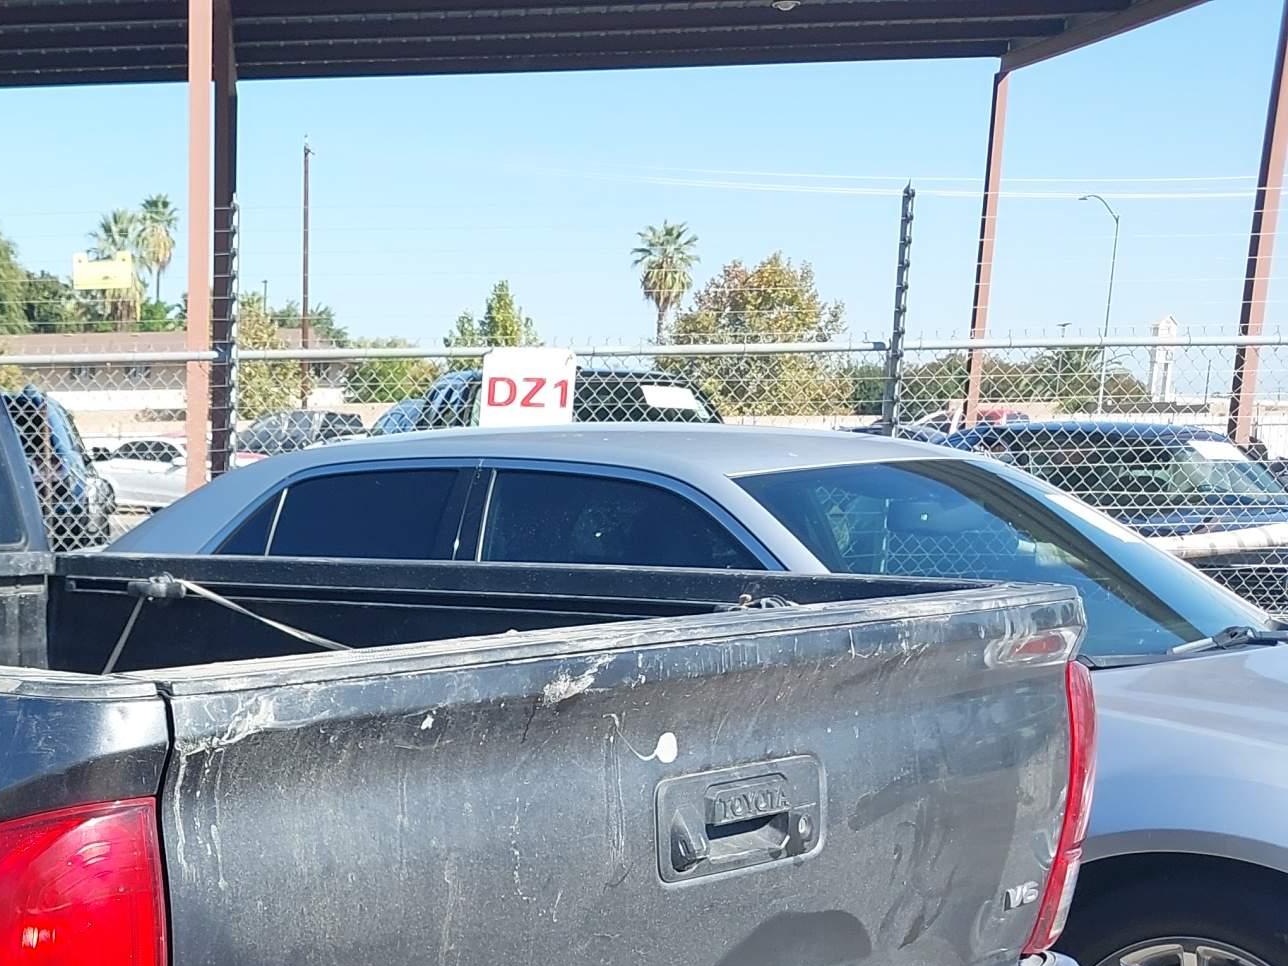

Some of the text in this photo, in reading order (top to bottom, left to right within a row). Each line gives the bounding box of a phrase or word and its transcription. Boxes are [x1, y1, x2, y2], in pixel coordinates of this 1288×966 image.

[488, 377, 568, 408] DZ1
[717, 785, 789, 820] TOYOTA
[1004, 881, 1039, 909] V6
